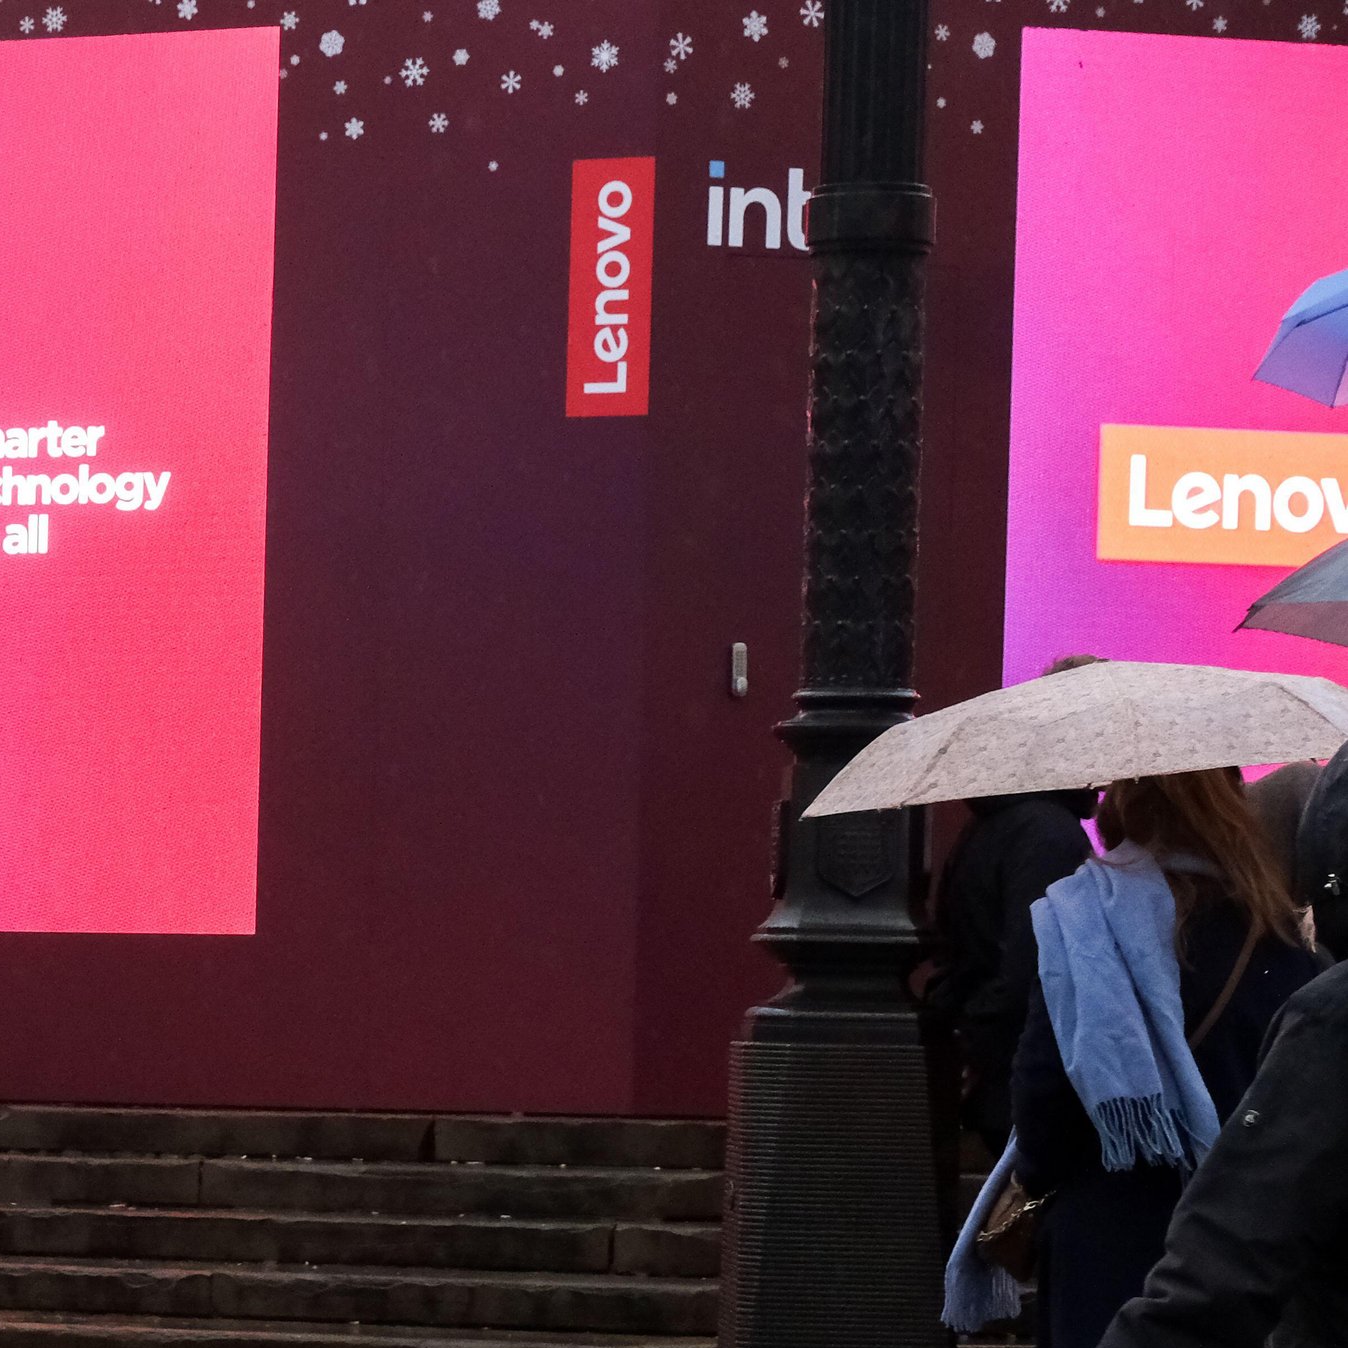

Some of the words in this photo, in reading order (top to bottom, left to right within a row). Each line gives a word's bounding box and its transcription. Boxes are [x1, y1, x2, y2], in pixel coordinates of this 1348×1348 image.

[707, 160, 811, 251] int
[584, 180, 632, 394] Lenovo
[2, 513, 49, 555] all
[1128, 454, 1348, 534] Lenov
